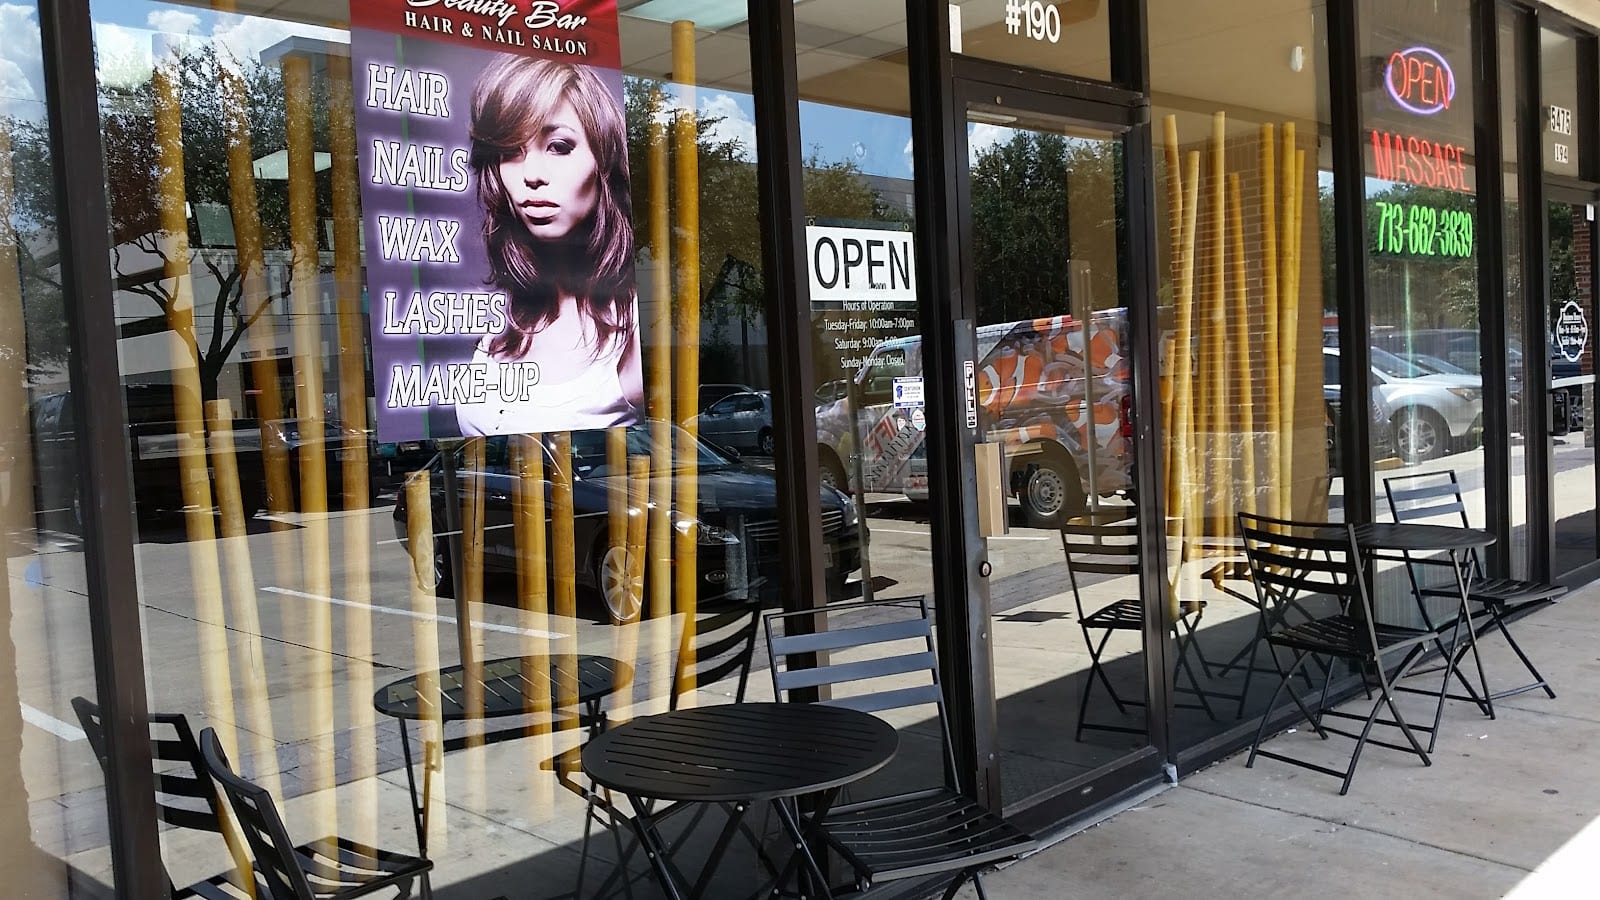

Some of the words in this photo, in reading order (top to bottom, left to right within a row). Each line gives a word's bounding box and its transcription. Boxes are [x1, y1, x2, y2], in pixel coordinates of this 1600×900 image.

[405, 11, 454, 35] HAIR
[461, 21, 474, 39] &
[482, 26, 525, 47] NAIL
[532, 34, 587, 56] SALON
[406, 0, 519, 27] eauty
[524, 1, 588, 31] Bar
[1005, 0, 1061, 43] #190
[367, 63, 450, 117] HAIR
[1389, 52, 1450, 109] OPEN
[1551, 106, 1571, 134] 5475
[372, 140, 469, 192] NAILS
[1372, 130, 1470, 191] MASSAGE
[379, 216, 460, 262] WAX
[1376, 202, 1473, 258] 713-662-3839
[814, 236, 910, 290] OPEN
[383, 292, 506, 335] LASHES
[824, 319, 868, 333] Tuesday-Friday:
[869, 317, 915, 331] 10:00am-7:00pm
[843, 299, 861, 311] Hours
[861, 300, 868, 310] of
[868, 300, 895, 313] Operation
[835, 338, 861, 351] Saturday:
[387, 362, 540, 408] MAKE-UP
[966, 366, 975, 412] PULL
